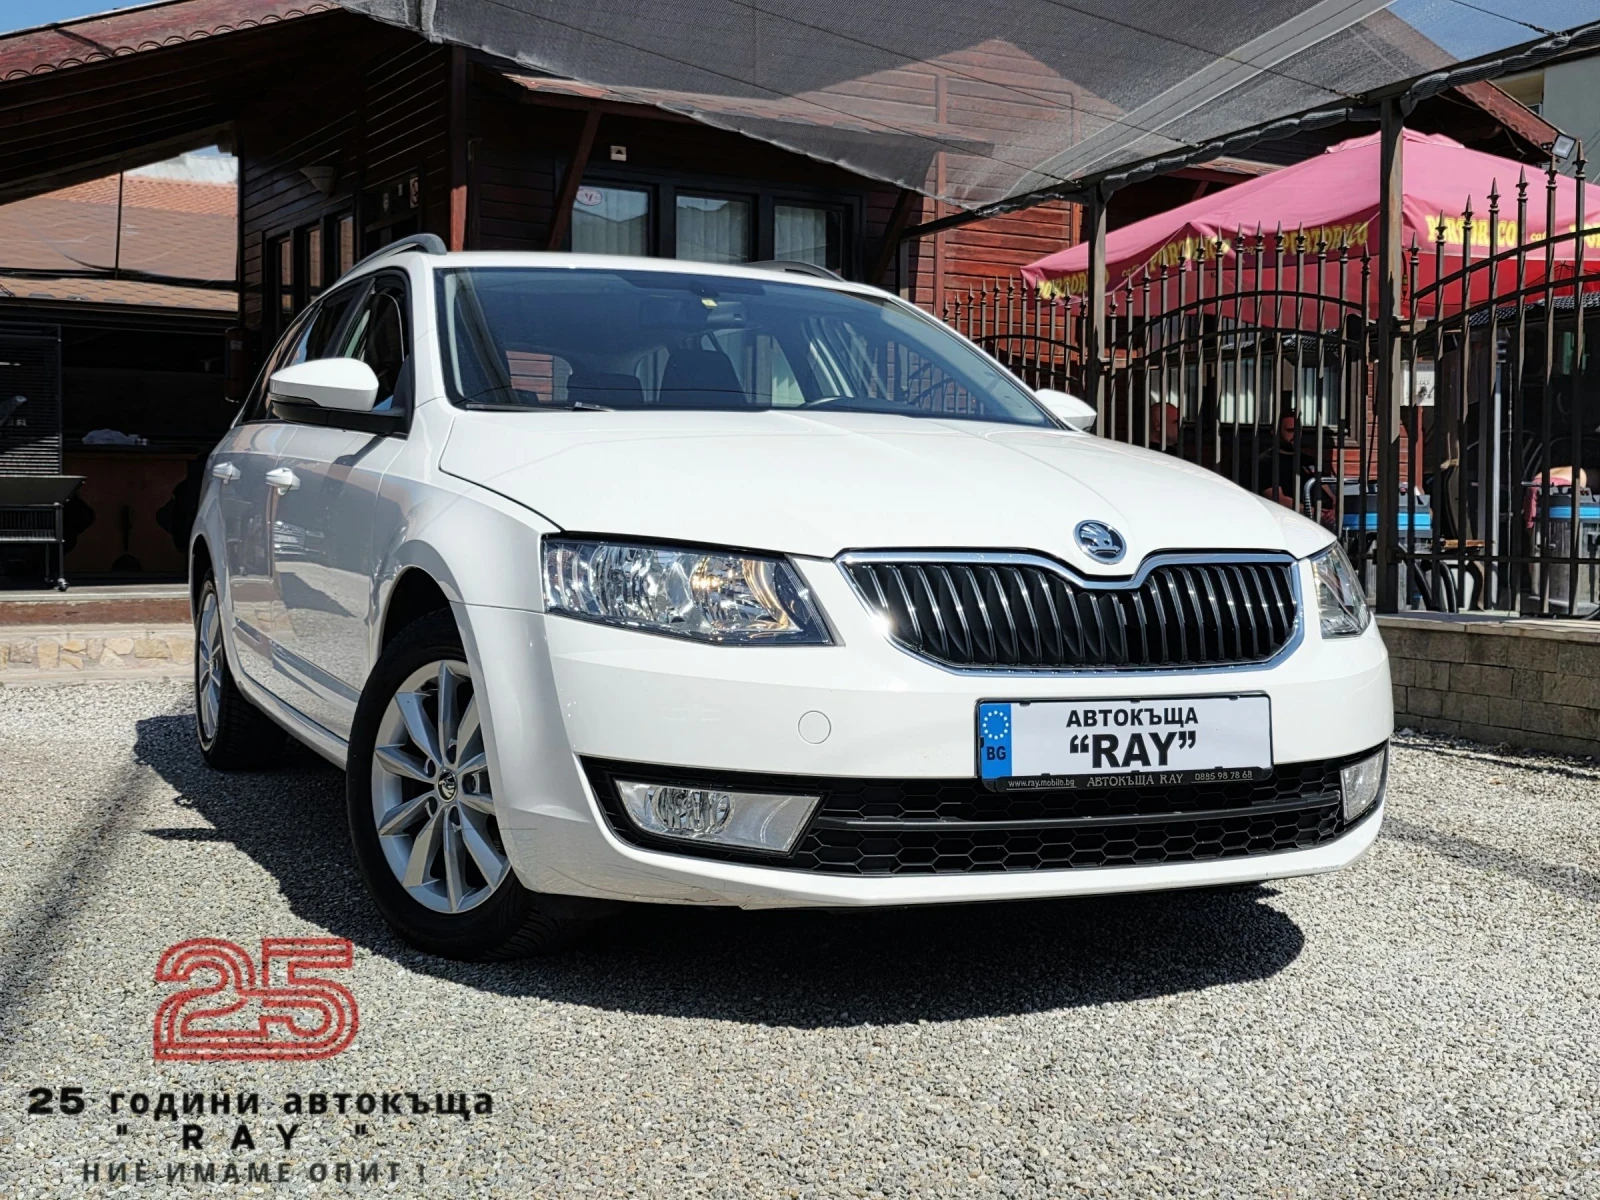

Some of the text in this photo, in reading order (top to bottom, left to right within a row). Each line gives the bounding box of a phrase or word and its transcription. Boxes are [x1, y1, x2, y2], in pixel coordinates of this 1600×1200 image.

[1066, 707, 1199, 728] АВТОКЪЩА
[986, 745, 1007, 761] BG
[1086, 773, 1184, 787] АВТОКЪЩА RAY
[1217, 771, 1229, 780] 98
[1230, 771, 1241, 779] 78
